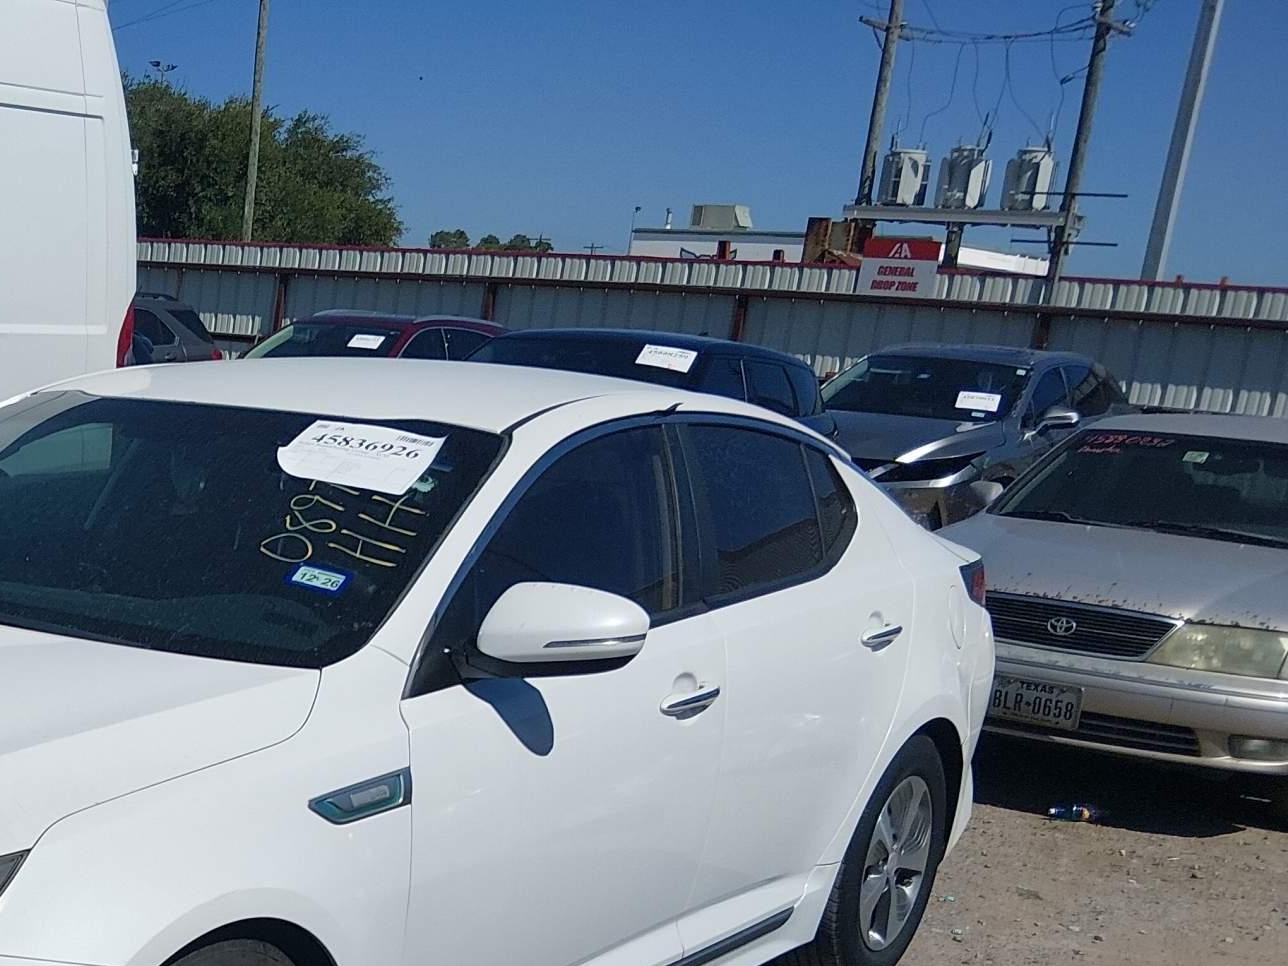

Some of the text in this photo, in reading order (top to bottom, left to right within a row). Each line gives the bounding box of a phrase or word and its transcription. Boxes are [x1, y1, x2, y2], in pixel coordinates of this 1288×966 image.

[877, 265, 915, 277] GENERAL
[870, 279, 919, 292] DROP ZONE
[312, 432, 419, 460] 45836926
[260, 480, 360, 563] 089
[1019, 681, 1054, 694] TEXAS
